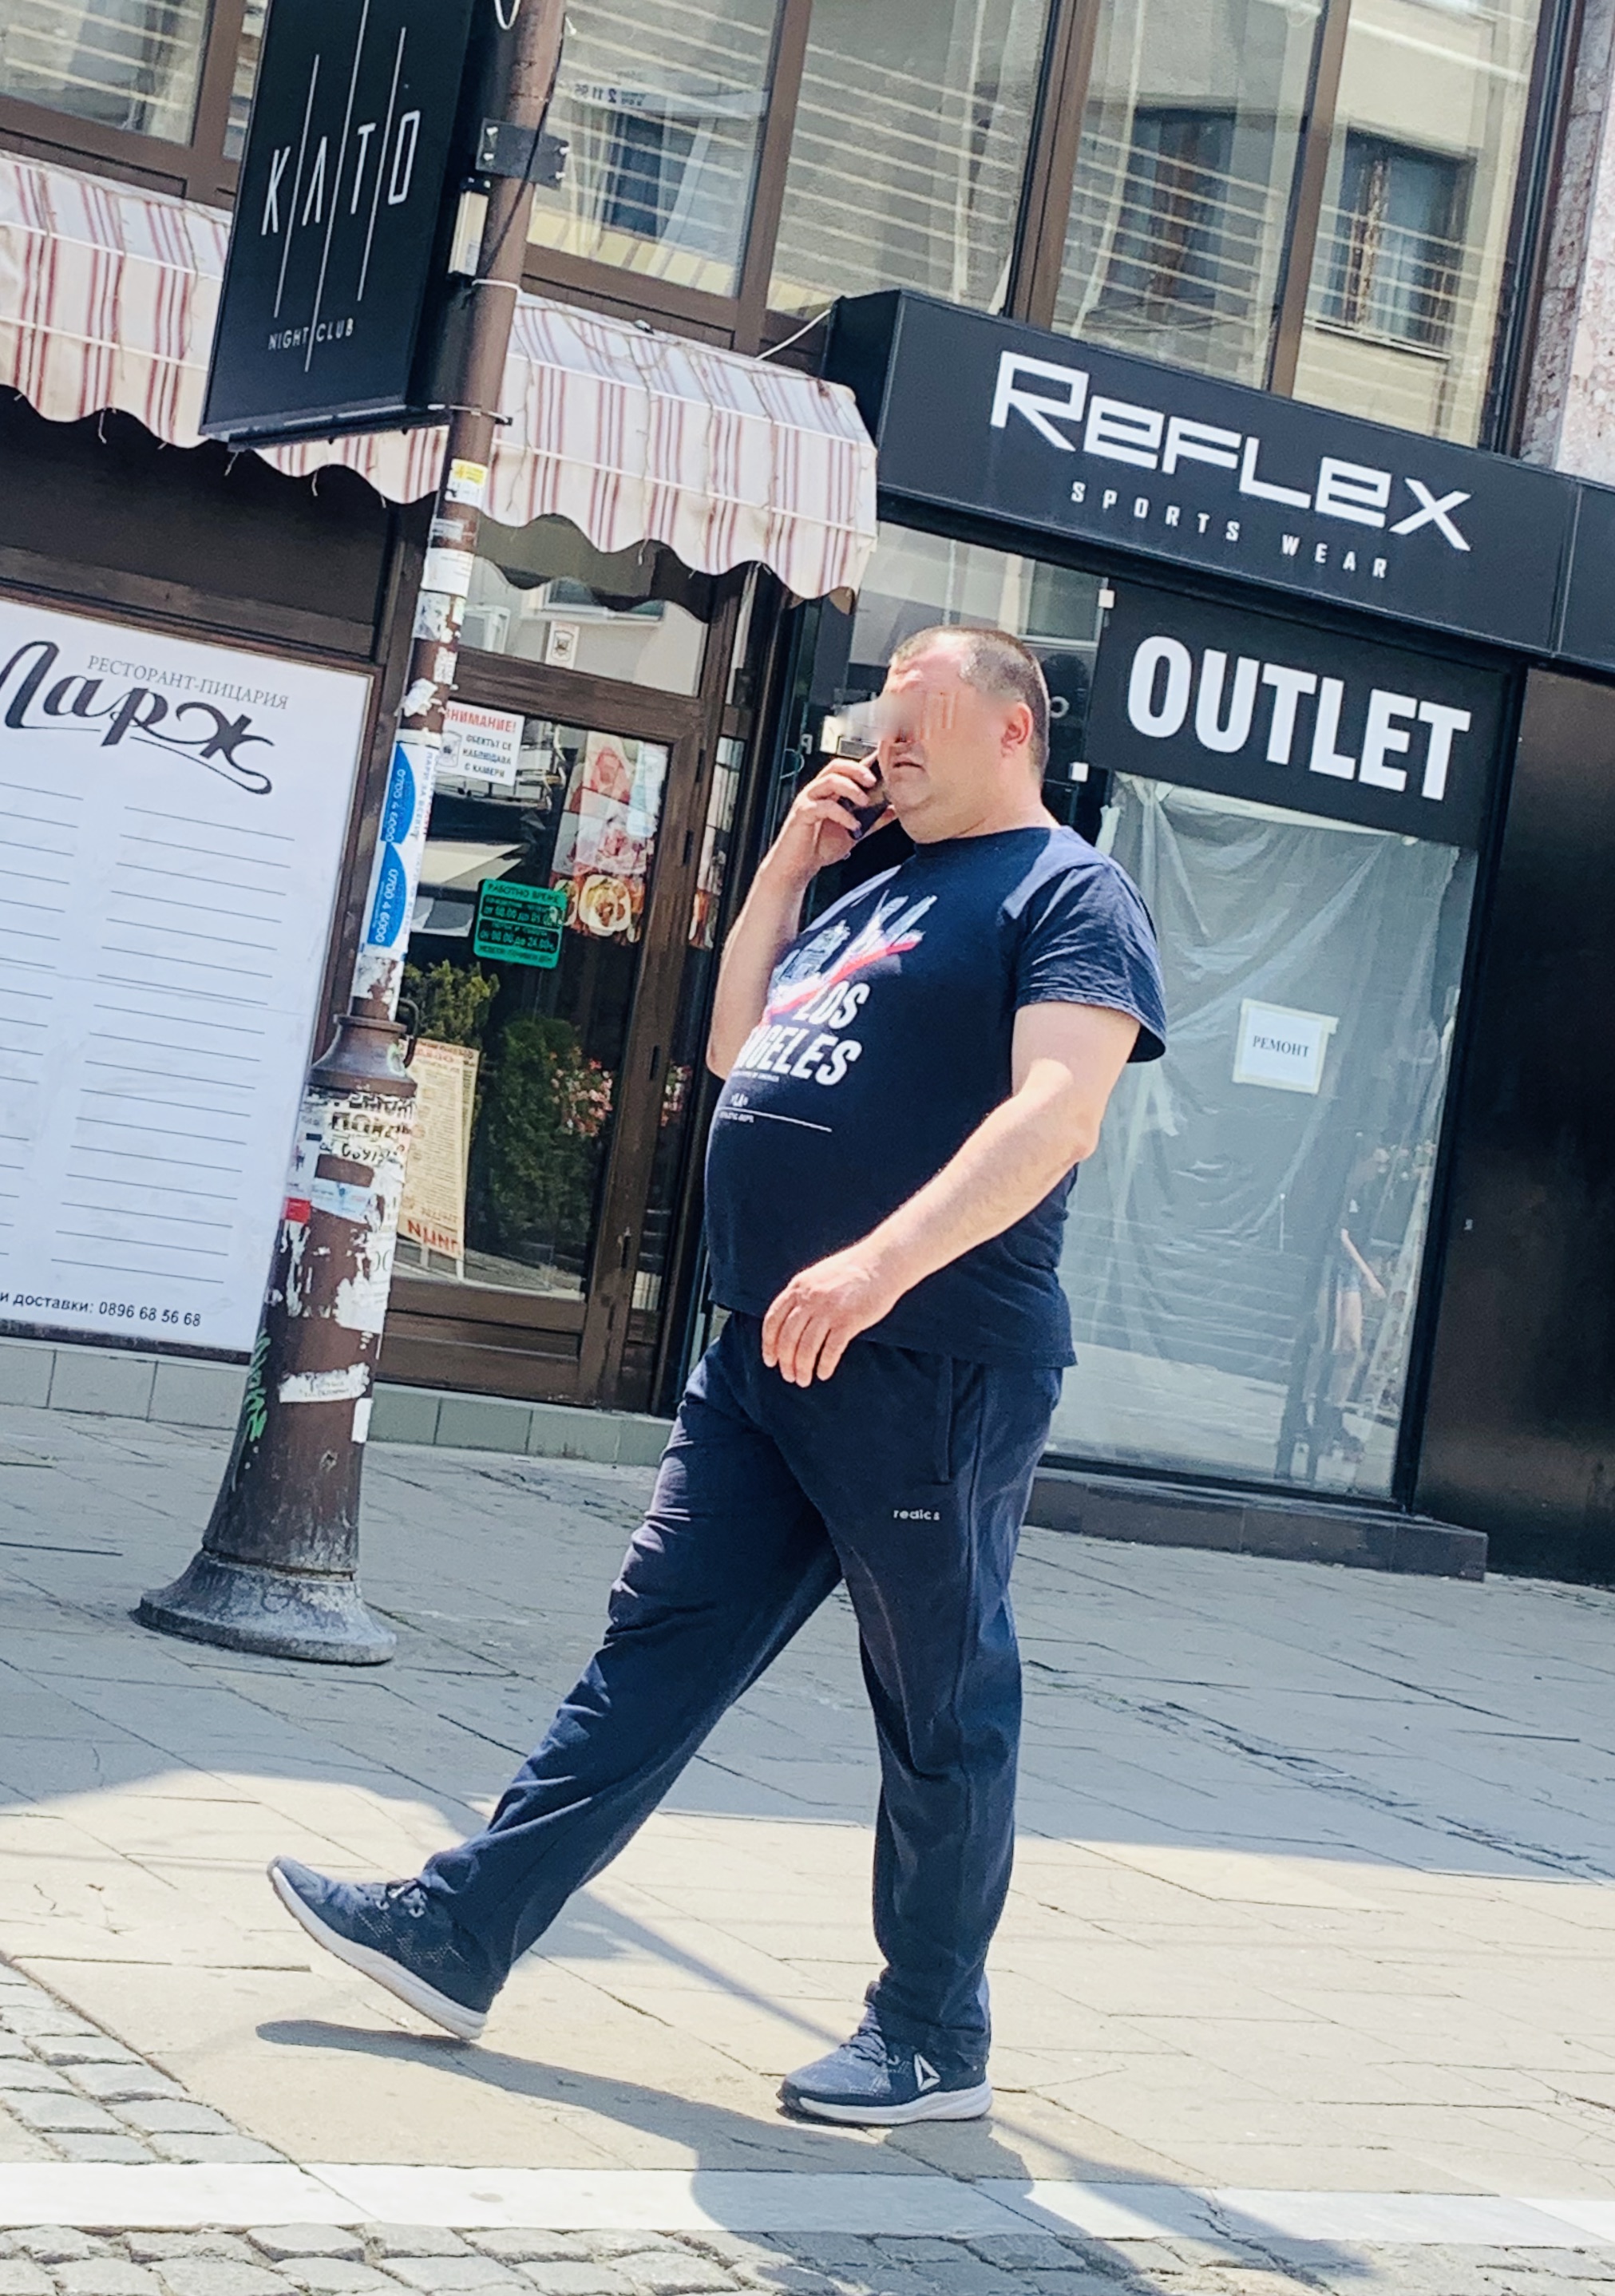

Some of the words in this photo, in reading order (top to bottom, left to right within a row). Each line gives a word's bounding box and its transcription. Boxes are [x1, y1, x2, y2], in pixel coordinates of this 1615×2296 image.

[268, 327, 309, 350] NIGHT
[316, 318, 354, 342] CLUB
[1071, 481, 1241, 541] SPORTS
[1282, 534, 1387, 579] WEAR
[88, 655, 289, 710] РЕСТОРАНТ-ПИЦАРИЯ
[1126, 635, 1471, 802] OUTLET
[384, 868, 398, 899] 0700
[375, 912, 390, 943] 6000
[792, 980, 870, 1029] LOS
[1252, 1035, 1309, 1058] РЕМОНТ
[13, 1292, 93, 1313] доставки:
[99, 1301, 135, 1318] 0896
[139, 1307, 157, 1321] 68
[161, 1309, 179, 1324] 56
[183, 1312, 201, 1327] 68
